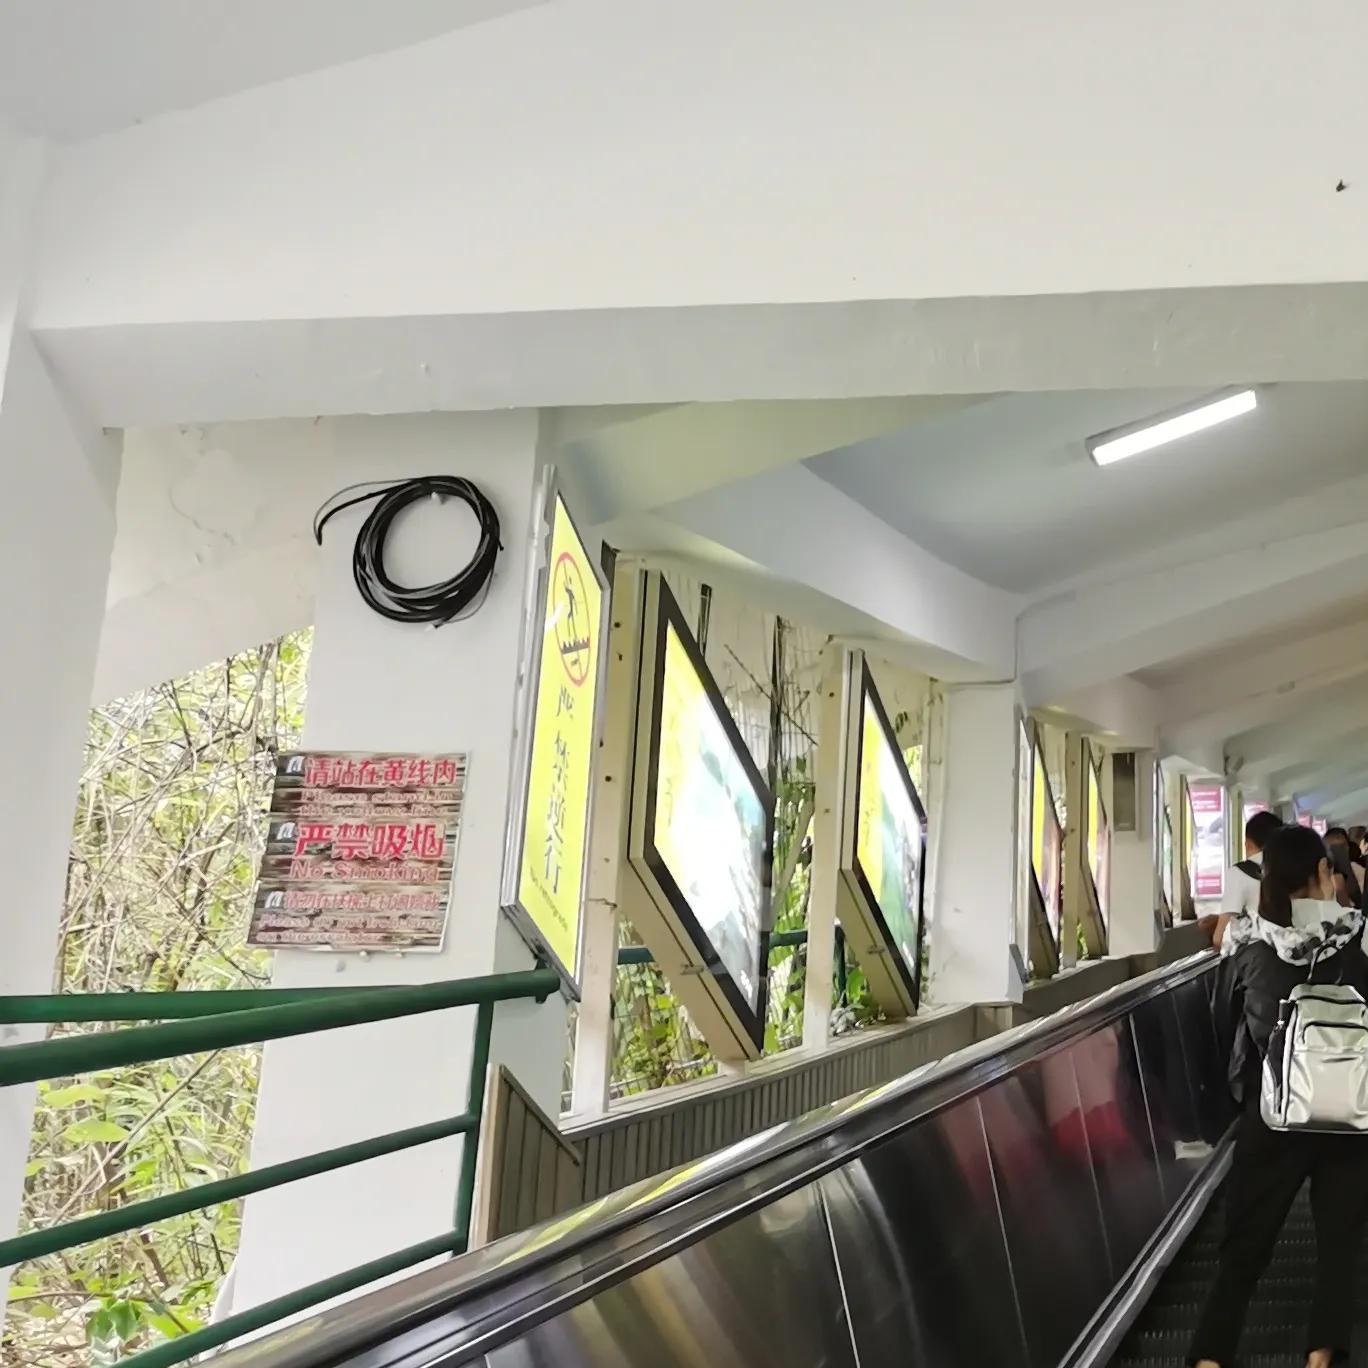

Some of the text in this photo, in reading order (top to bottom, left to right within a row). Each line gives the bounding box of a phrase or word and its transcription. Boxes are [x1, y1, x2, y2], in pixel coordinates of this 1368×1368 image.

[304, 757, 457, 787] 请站在黄线内
[544, 683, 575, 895] 严禁逆行
[294, 822, 445, 860] 严禁吸烟
[290, 861, 439, 883] No Smoking
